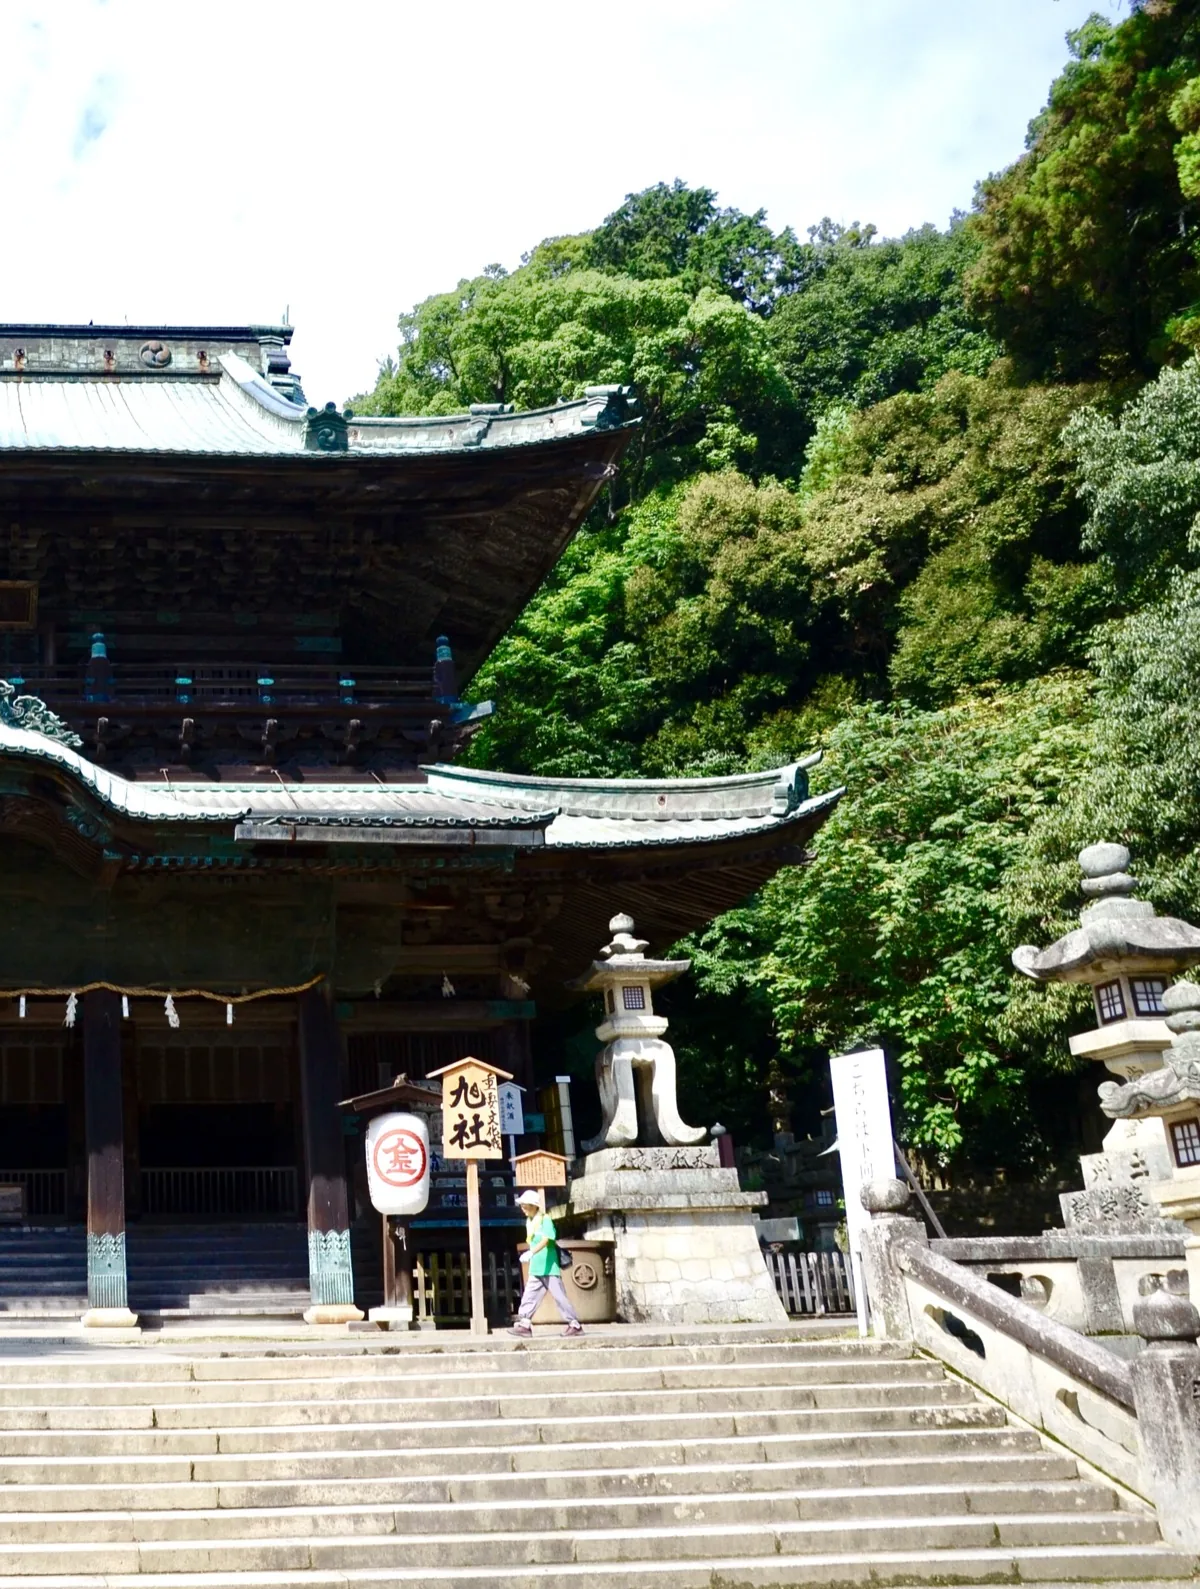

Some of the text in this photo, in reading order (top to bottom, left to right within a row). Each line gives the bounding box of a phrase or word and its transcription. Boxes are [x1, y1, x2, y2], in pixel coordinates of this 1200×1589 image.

[449, 1075, 491, 1150] 旭社
[852, 1064, 873, 1182] こちらは下向
[383, 1138, 418, 1175] 金
